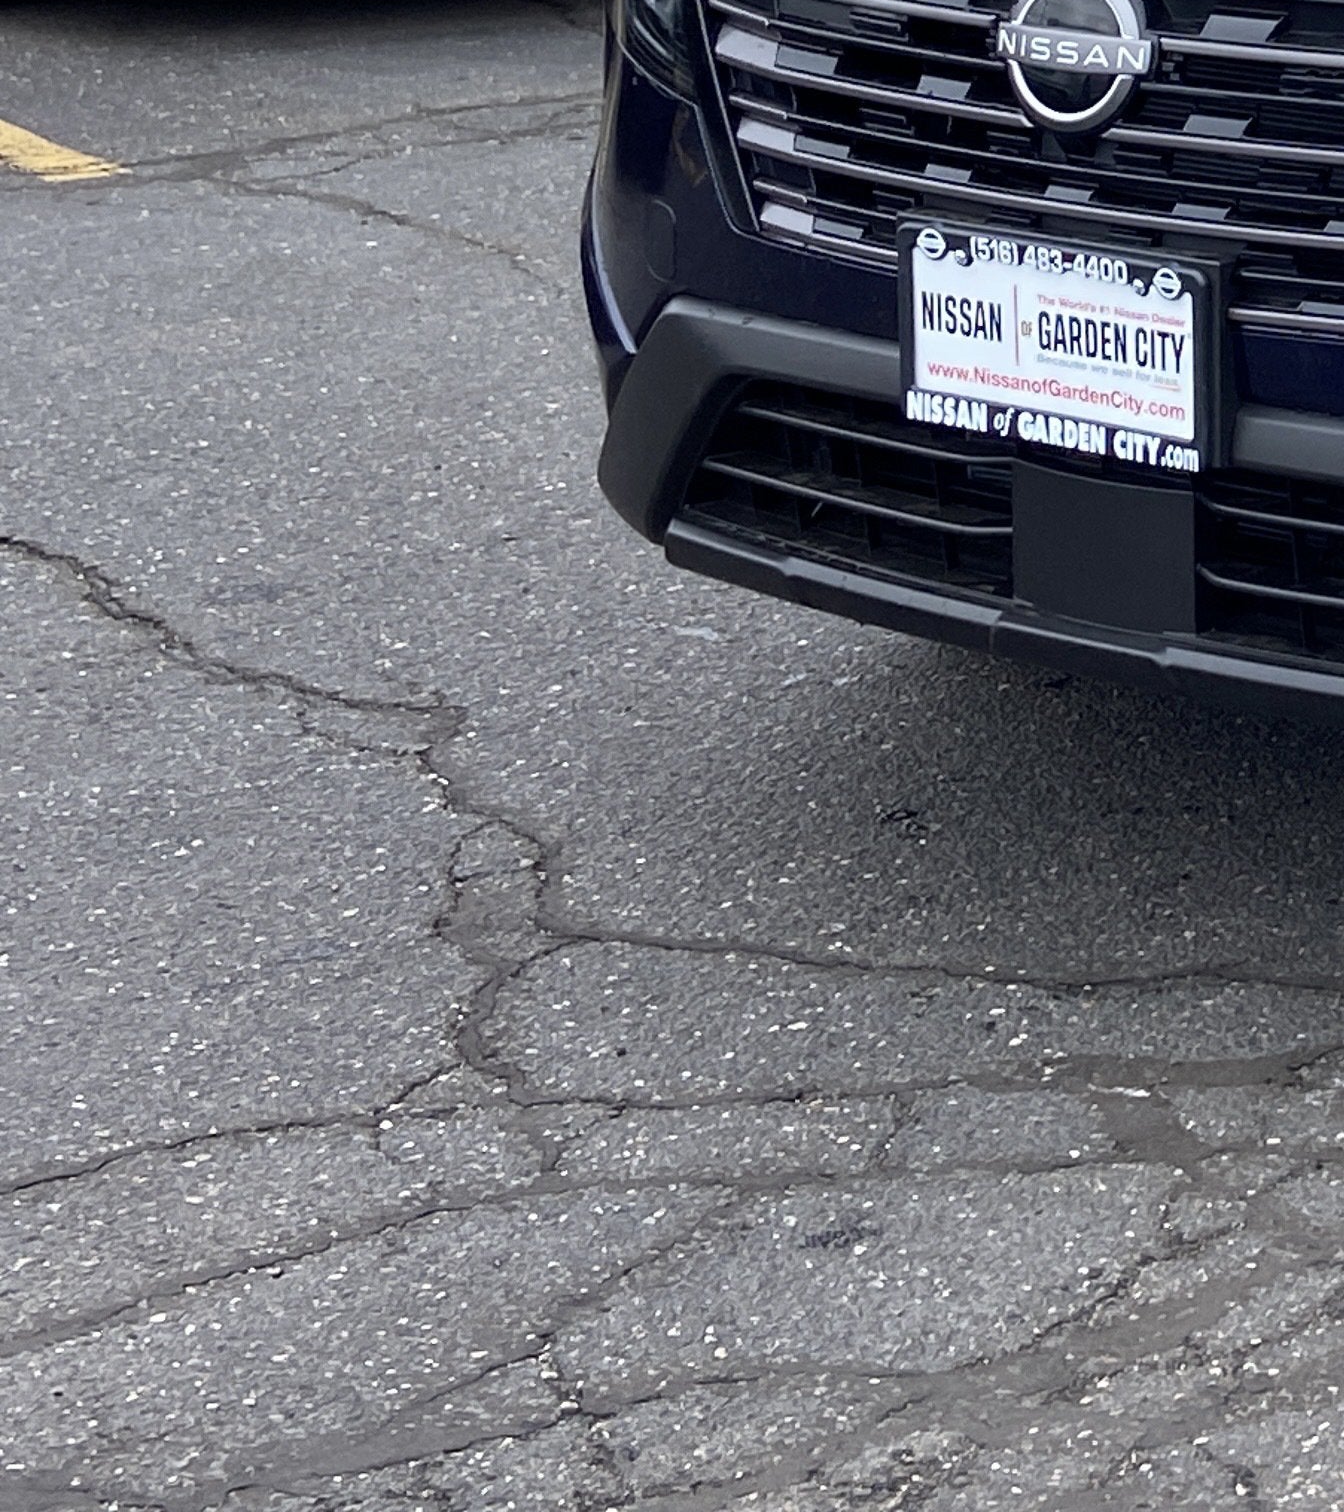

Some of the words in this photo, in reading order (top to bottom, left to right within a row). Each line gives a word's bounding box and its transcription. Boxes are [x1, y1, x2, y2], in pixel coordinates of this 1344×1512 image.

[997, 28, 1146, 71] NISSAN
[970, 235, 1019, 267] (516)
[1023, 244, 1128, 285] 483-4400
[921, 290, 1002, 342] NISSAN
[1038, 310, 1128, 364] GARDEN
[1135, 326, 1186, 374] CITY
[927, 360, 1187, 421] www.NissanofGardenCity.com
[906, 389, 988, 433] NISSAN
[993, 406, 1015, 438] of
[1017, 410, 1106, 455] GARDEN
